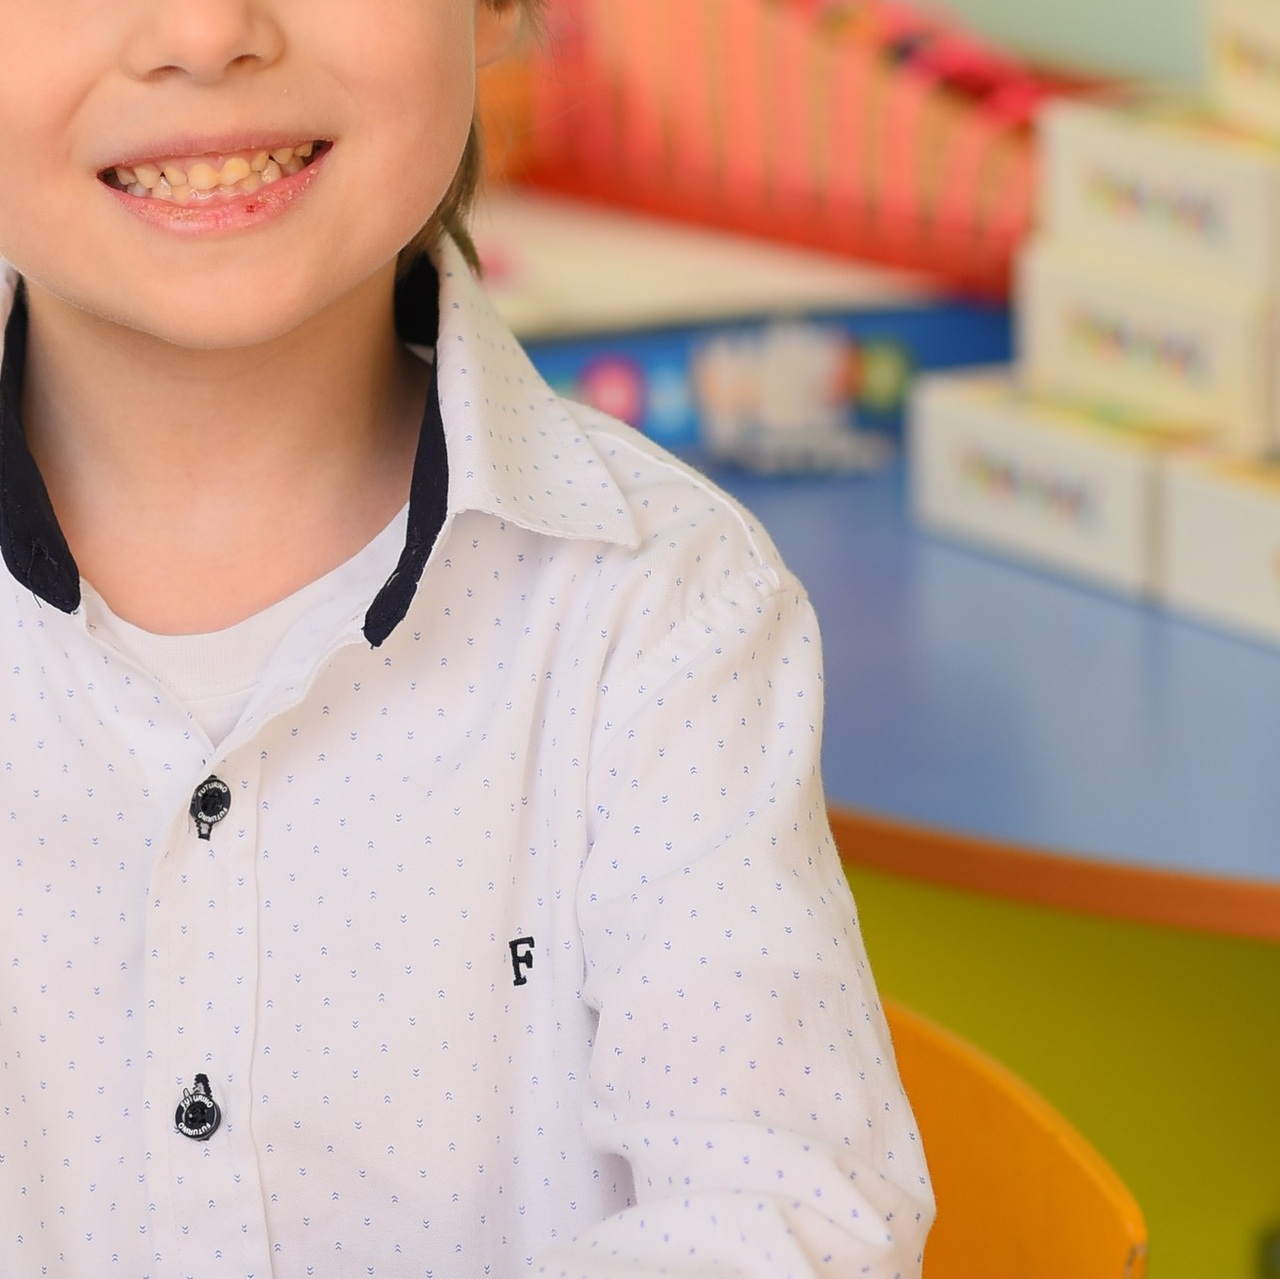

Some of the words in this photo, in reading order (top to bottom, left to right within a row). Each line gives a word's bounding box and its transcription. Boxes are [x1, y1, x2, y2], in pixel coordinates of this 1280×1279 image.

[197, 781, 228, 797] FUTURINO
[197, 807, 228, 823] FUTURINO
[508, 936, 535, 986] F
